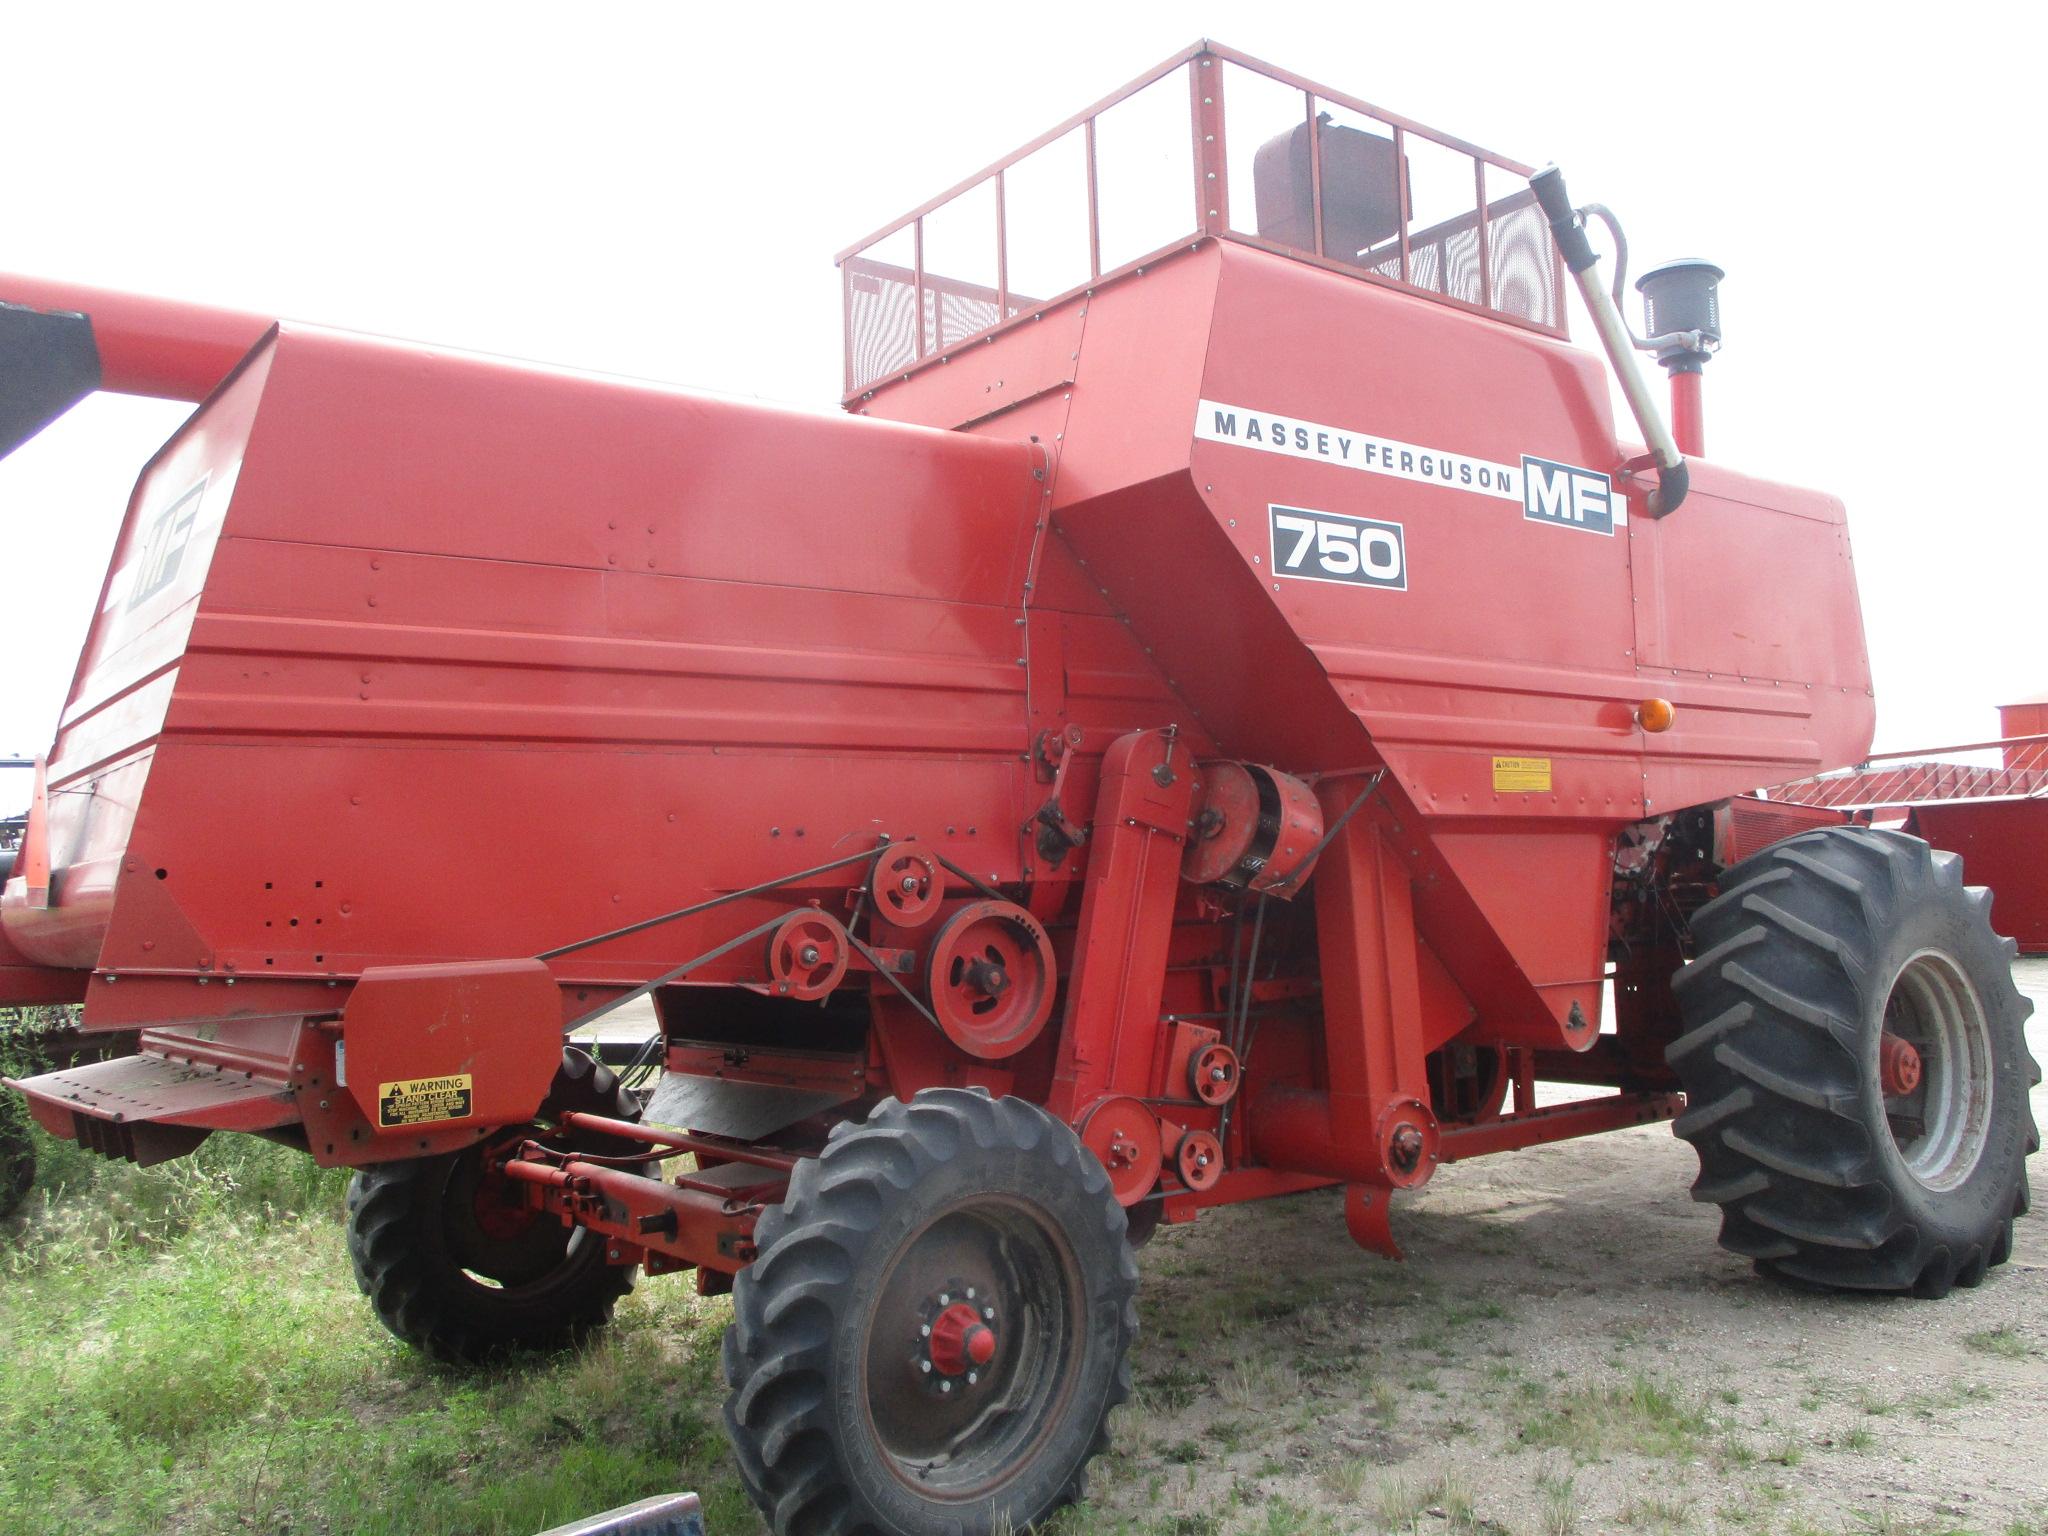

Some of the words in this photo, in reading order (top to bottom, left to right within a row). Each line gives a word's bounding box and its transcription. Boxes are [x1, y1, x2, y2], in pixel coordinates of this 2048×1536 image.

[1214, 410, 1351, 459] MASSEY
[1365, 443, 1511, 493] FERGUSON
[1526, 463, 1608, 523] MF
[1275, 514, 1401, 581] 750
[395, 1094, 426, 1105] STAND
[428, 1090, 458, 1100] CLEAR
[410, 1078, 463, 1094] WARNING
